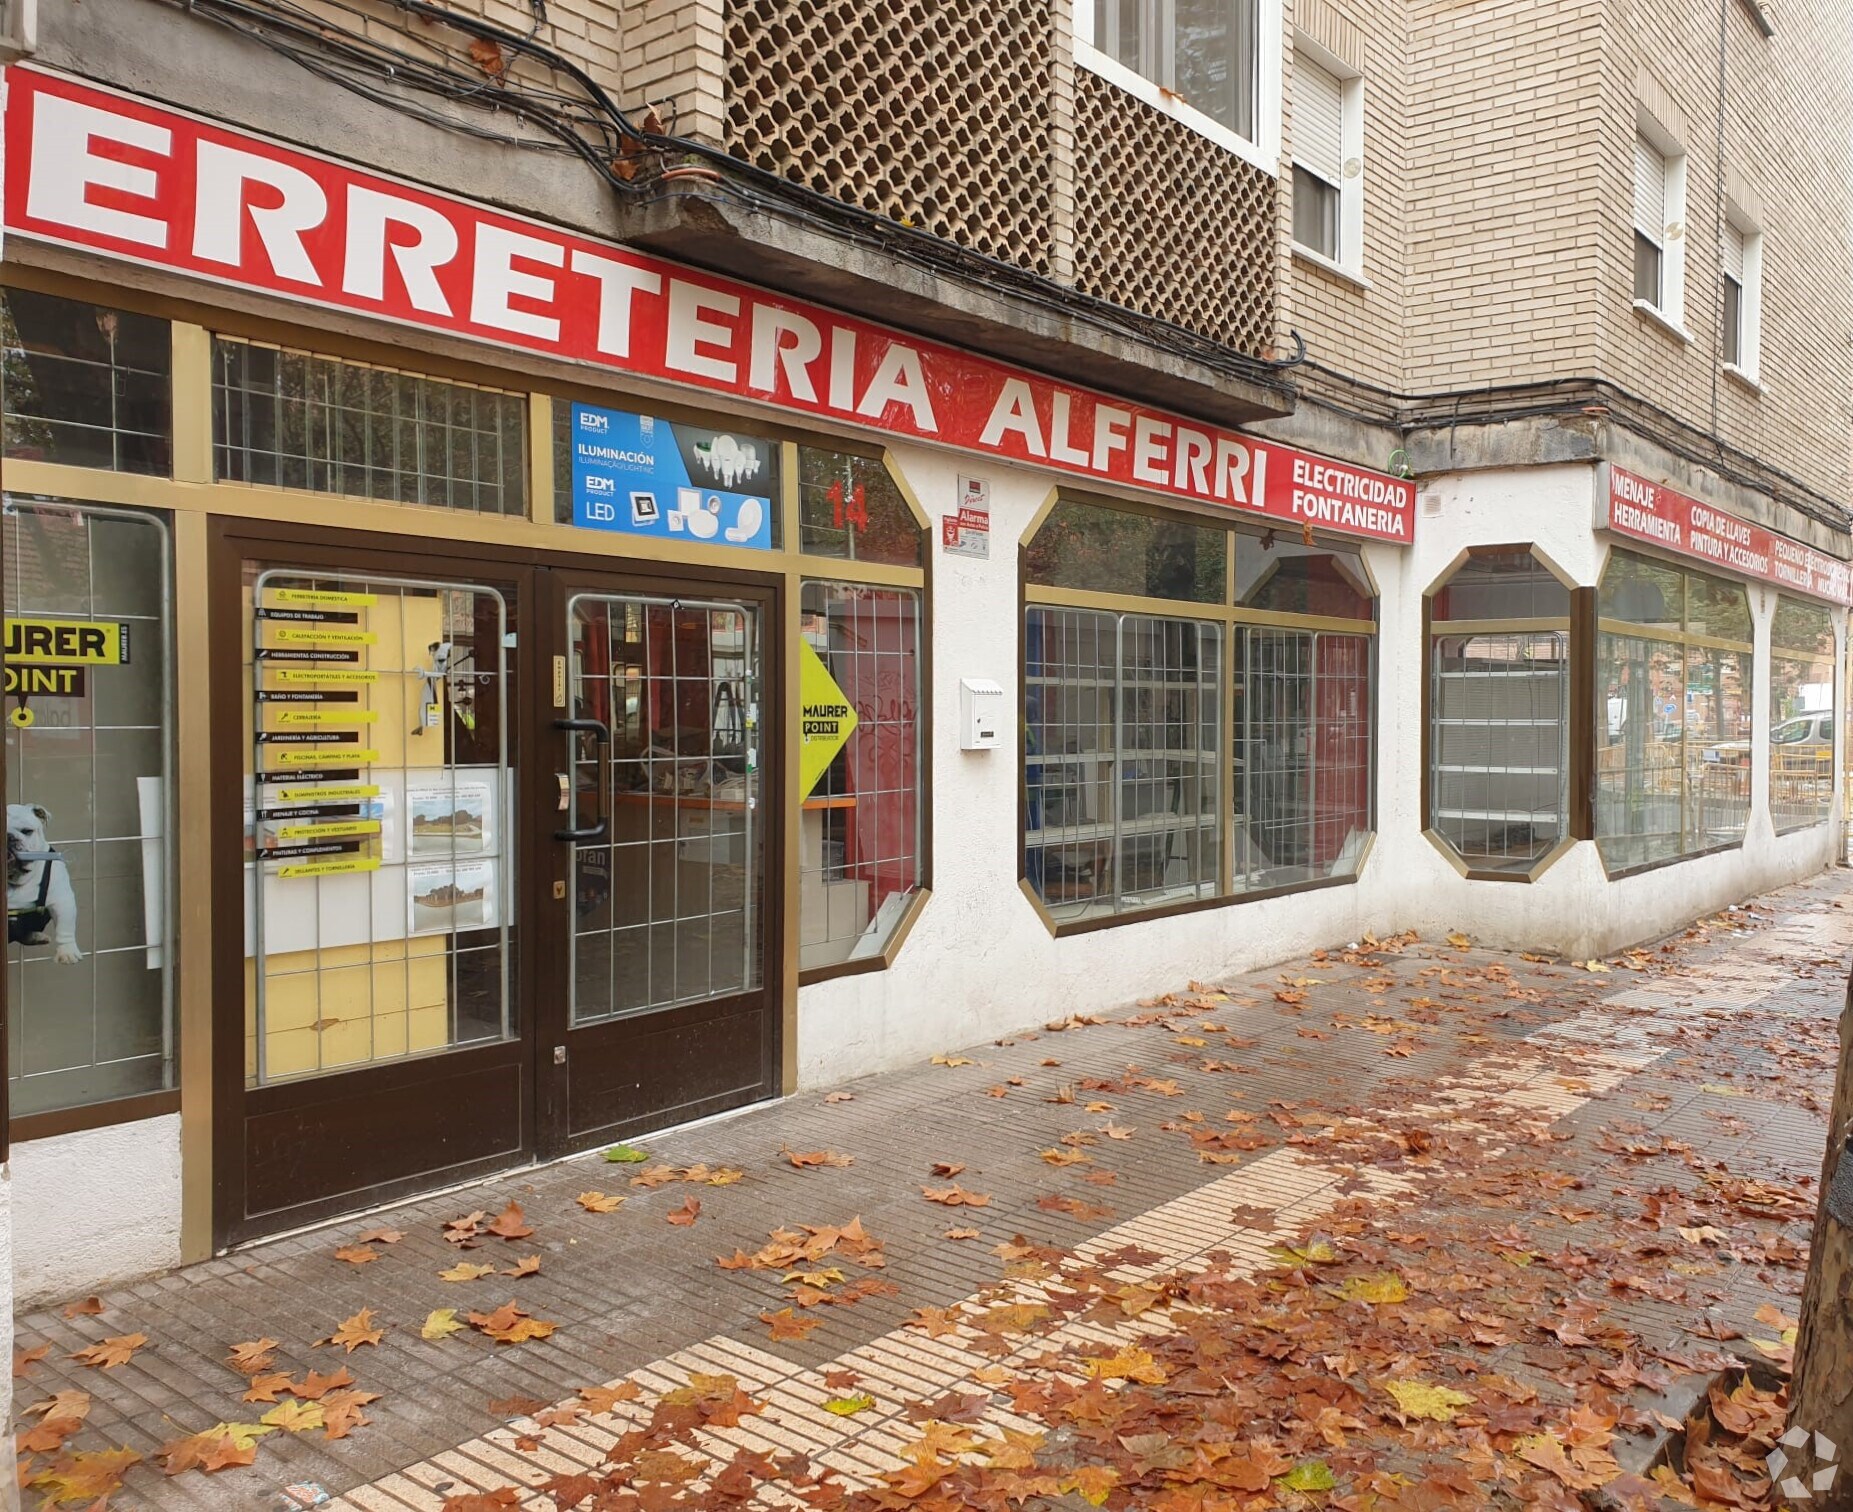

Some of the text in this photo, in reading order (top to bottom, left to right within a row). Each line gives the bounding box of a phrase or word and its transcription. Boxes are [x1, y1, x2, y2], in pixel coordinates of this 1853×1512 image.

[5, 84, 1267, 507] ERRETERIA ALFERRI
[580, 412, 608, 429] EDM
[580, 425, 608, 435] PRODUCT
[578, 443, 654, 466] ILUMINACIÓN
[586, 475, 616, 492] EDM
[586, 488, 615, 498] PRODUCT
[1293, 458, 1407, 508] ELECTRICIDAD
[1614, 475, 1655, 509] MENAJE
[586, 501, 615, 521] LED
[826, 479, 868, 535] 14
[960, 510, 989, 526] Alarma
[1292, 489, 1405, 536] FONTANERIA
[1614, 501, 1681, 545] HERRAMIENTA
[1690, 506, 1751, 546] COPIA DE LLAVES
[1690, 530, 1769, 574] PINTURA Y ACCESORIOS
[803, 704, 848, 718] MAURER
[804, 721, 838, 733] POINT
